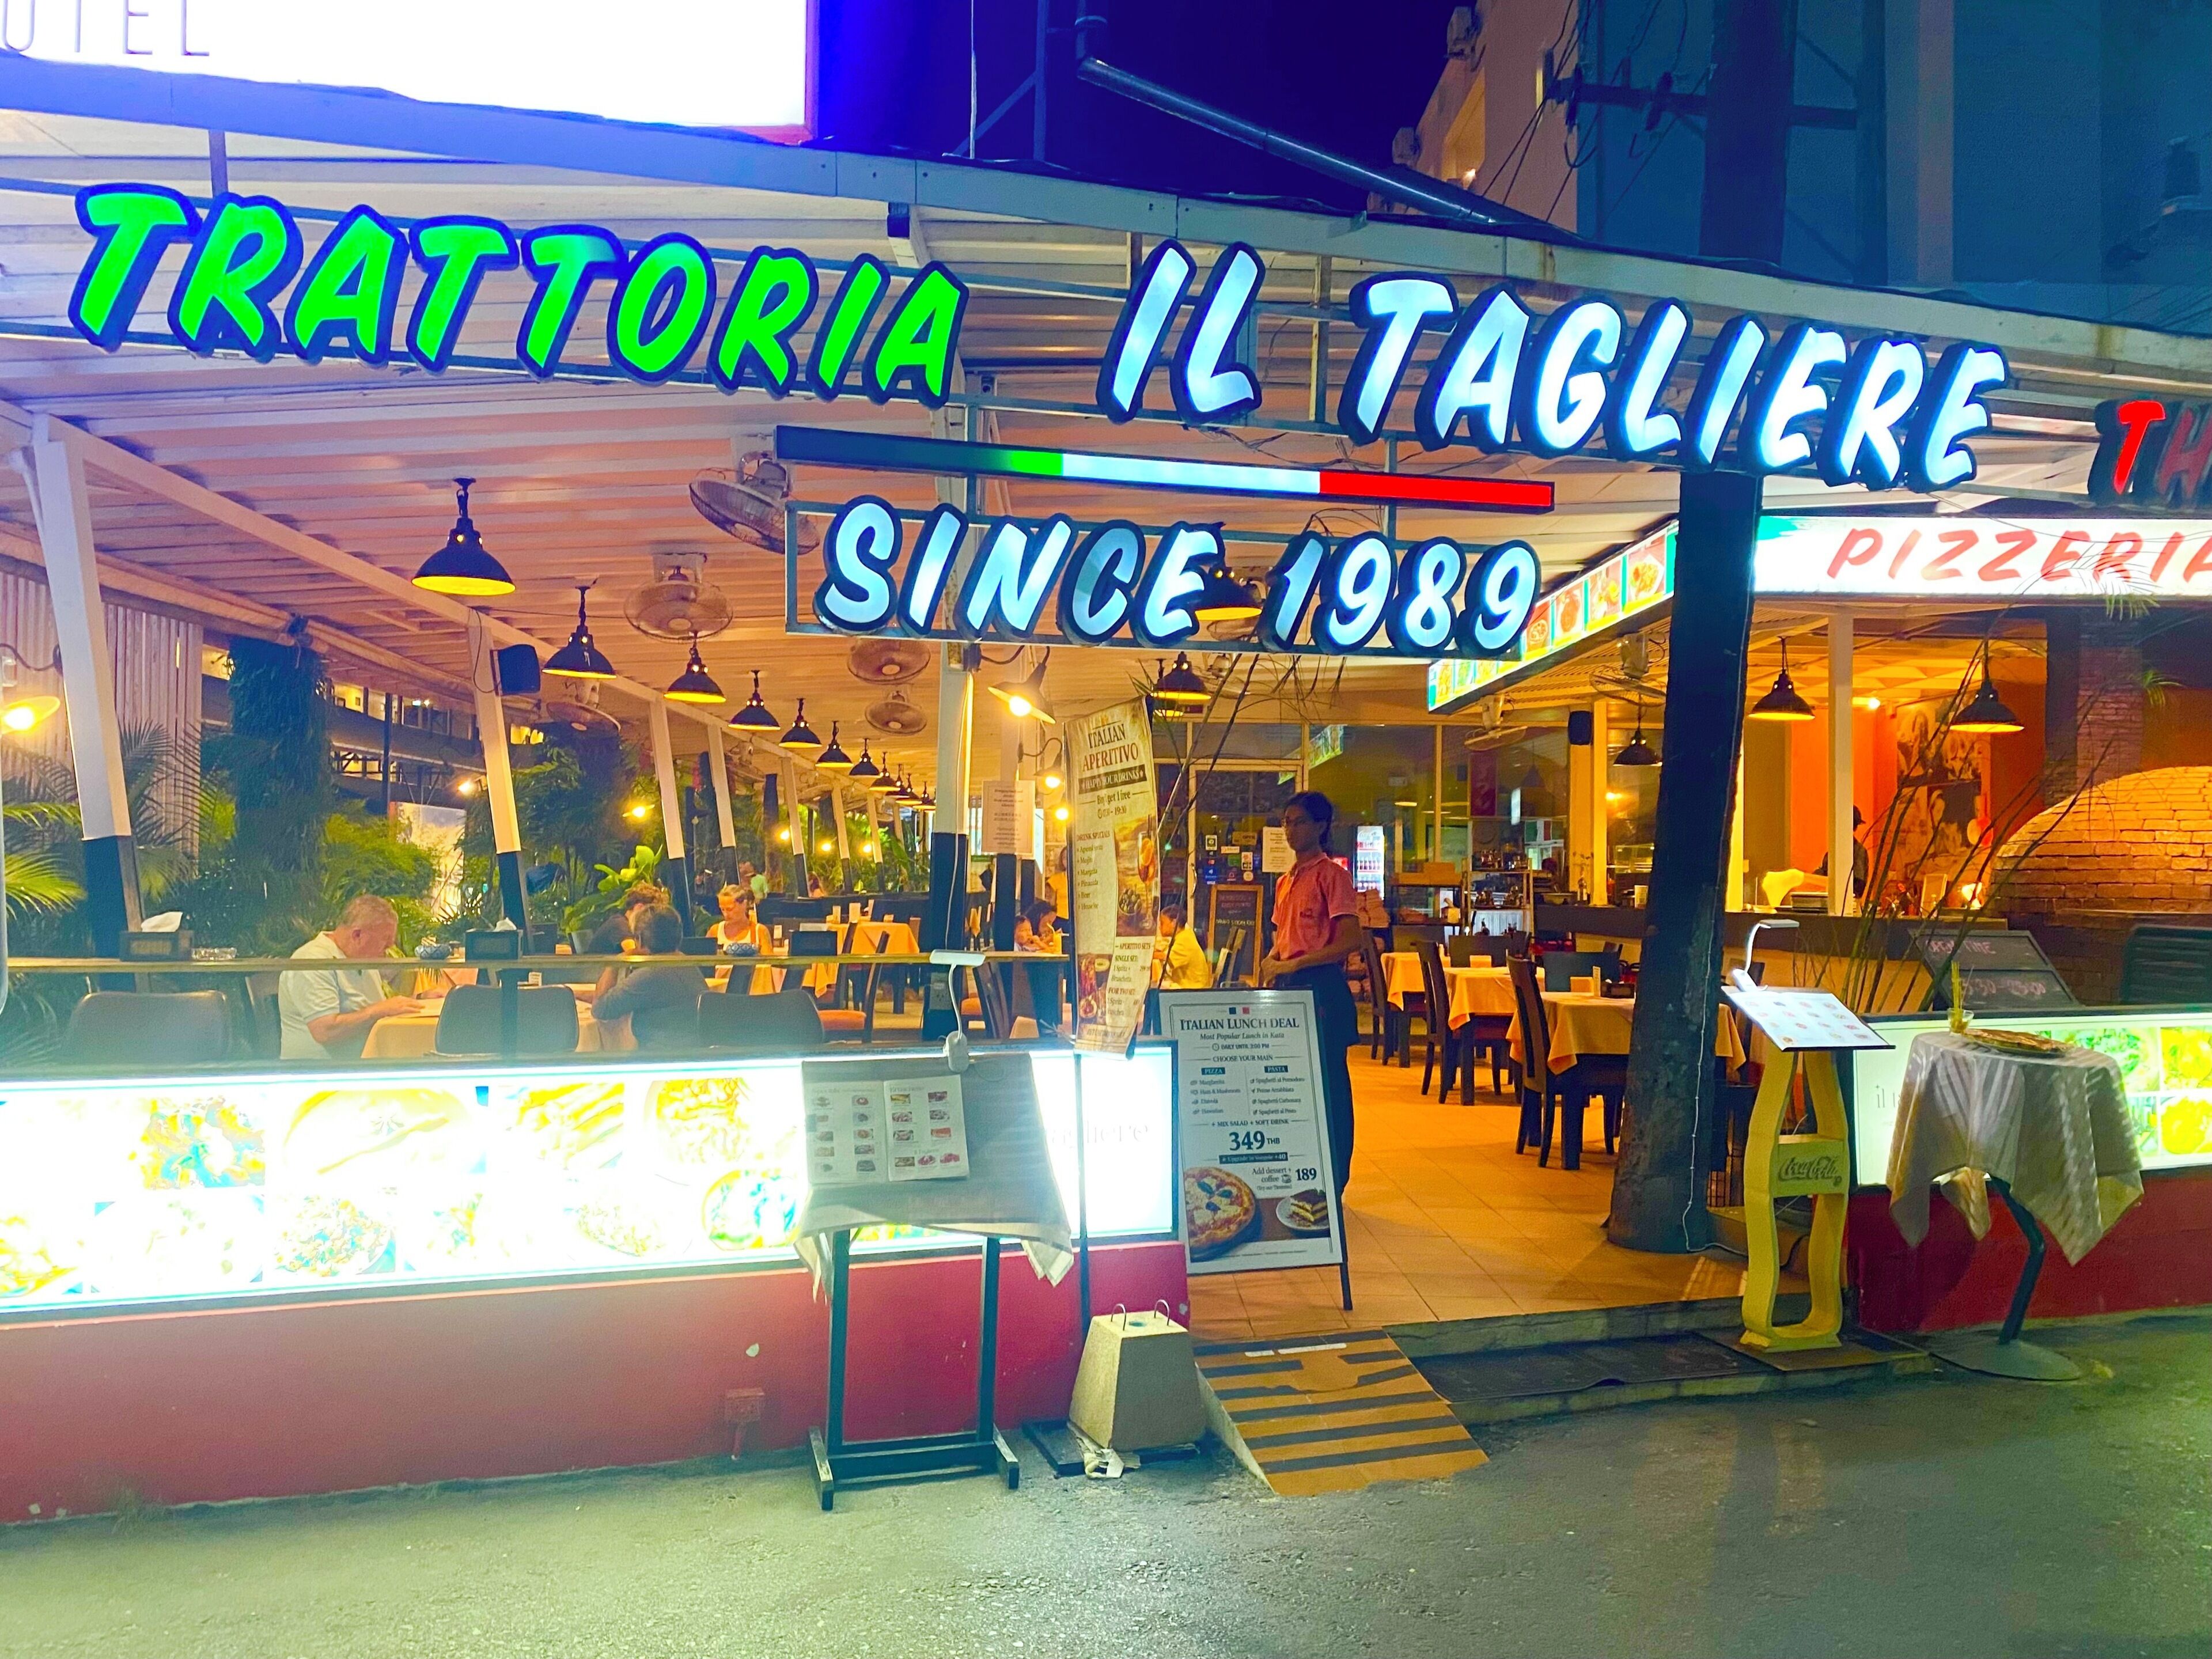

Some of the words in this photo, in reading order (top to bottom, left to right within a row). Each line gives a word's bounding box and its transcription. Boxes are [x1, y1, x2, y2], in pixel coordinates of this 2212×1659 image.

[70, 185, 968, 408] TRATTORIA
[1099, 240, 1263, 423] IL
[1341, 273, 2009, 490] TAGLIERE
[817, 497, 1221, 646] SINCE
[1264, 533, 1540, 653] 1989
[1088, 724, 1126, 749] ITALIAN
[1083, 742, 1138, 771] APERITIVO
[1118, 770, 1139, 783] DRINKS
[1107, 793, 1116, 805] get
[1180, 1019, 1224, 1031] ITALIAN
[1228, 1018, 1267, 1029] LUNCH
[1270, 1018, 1300, 1028] DEAL
[1217, 1033, 1240, 1041] Popular
[1229, 1130, 1266, 1151] 349
[1261, 1175, 1279, 1183] coffee
[1296, 1168, 1317, 1181] 189
